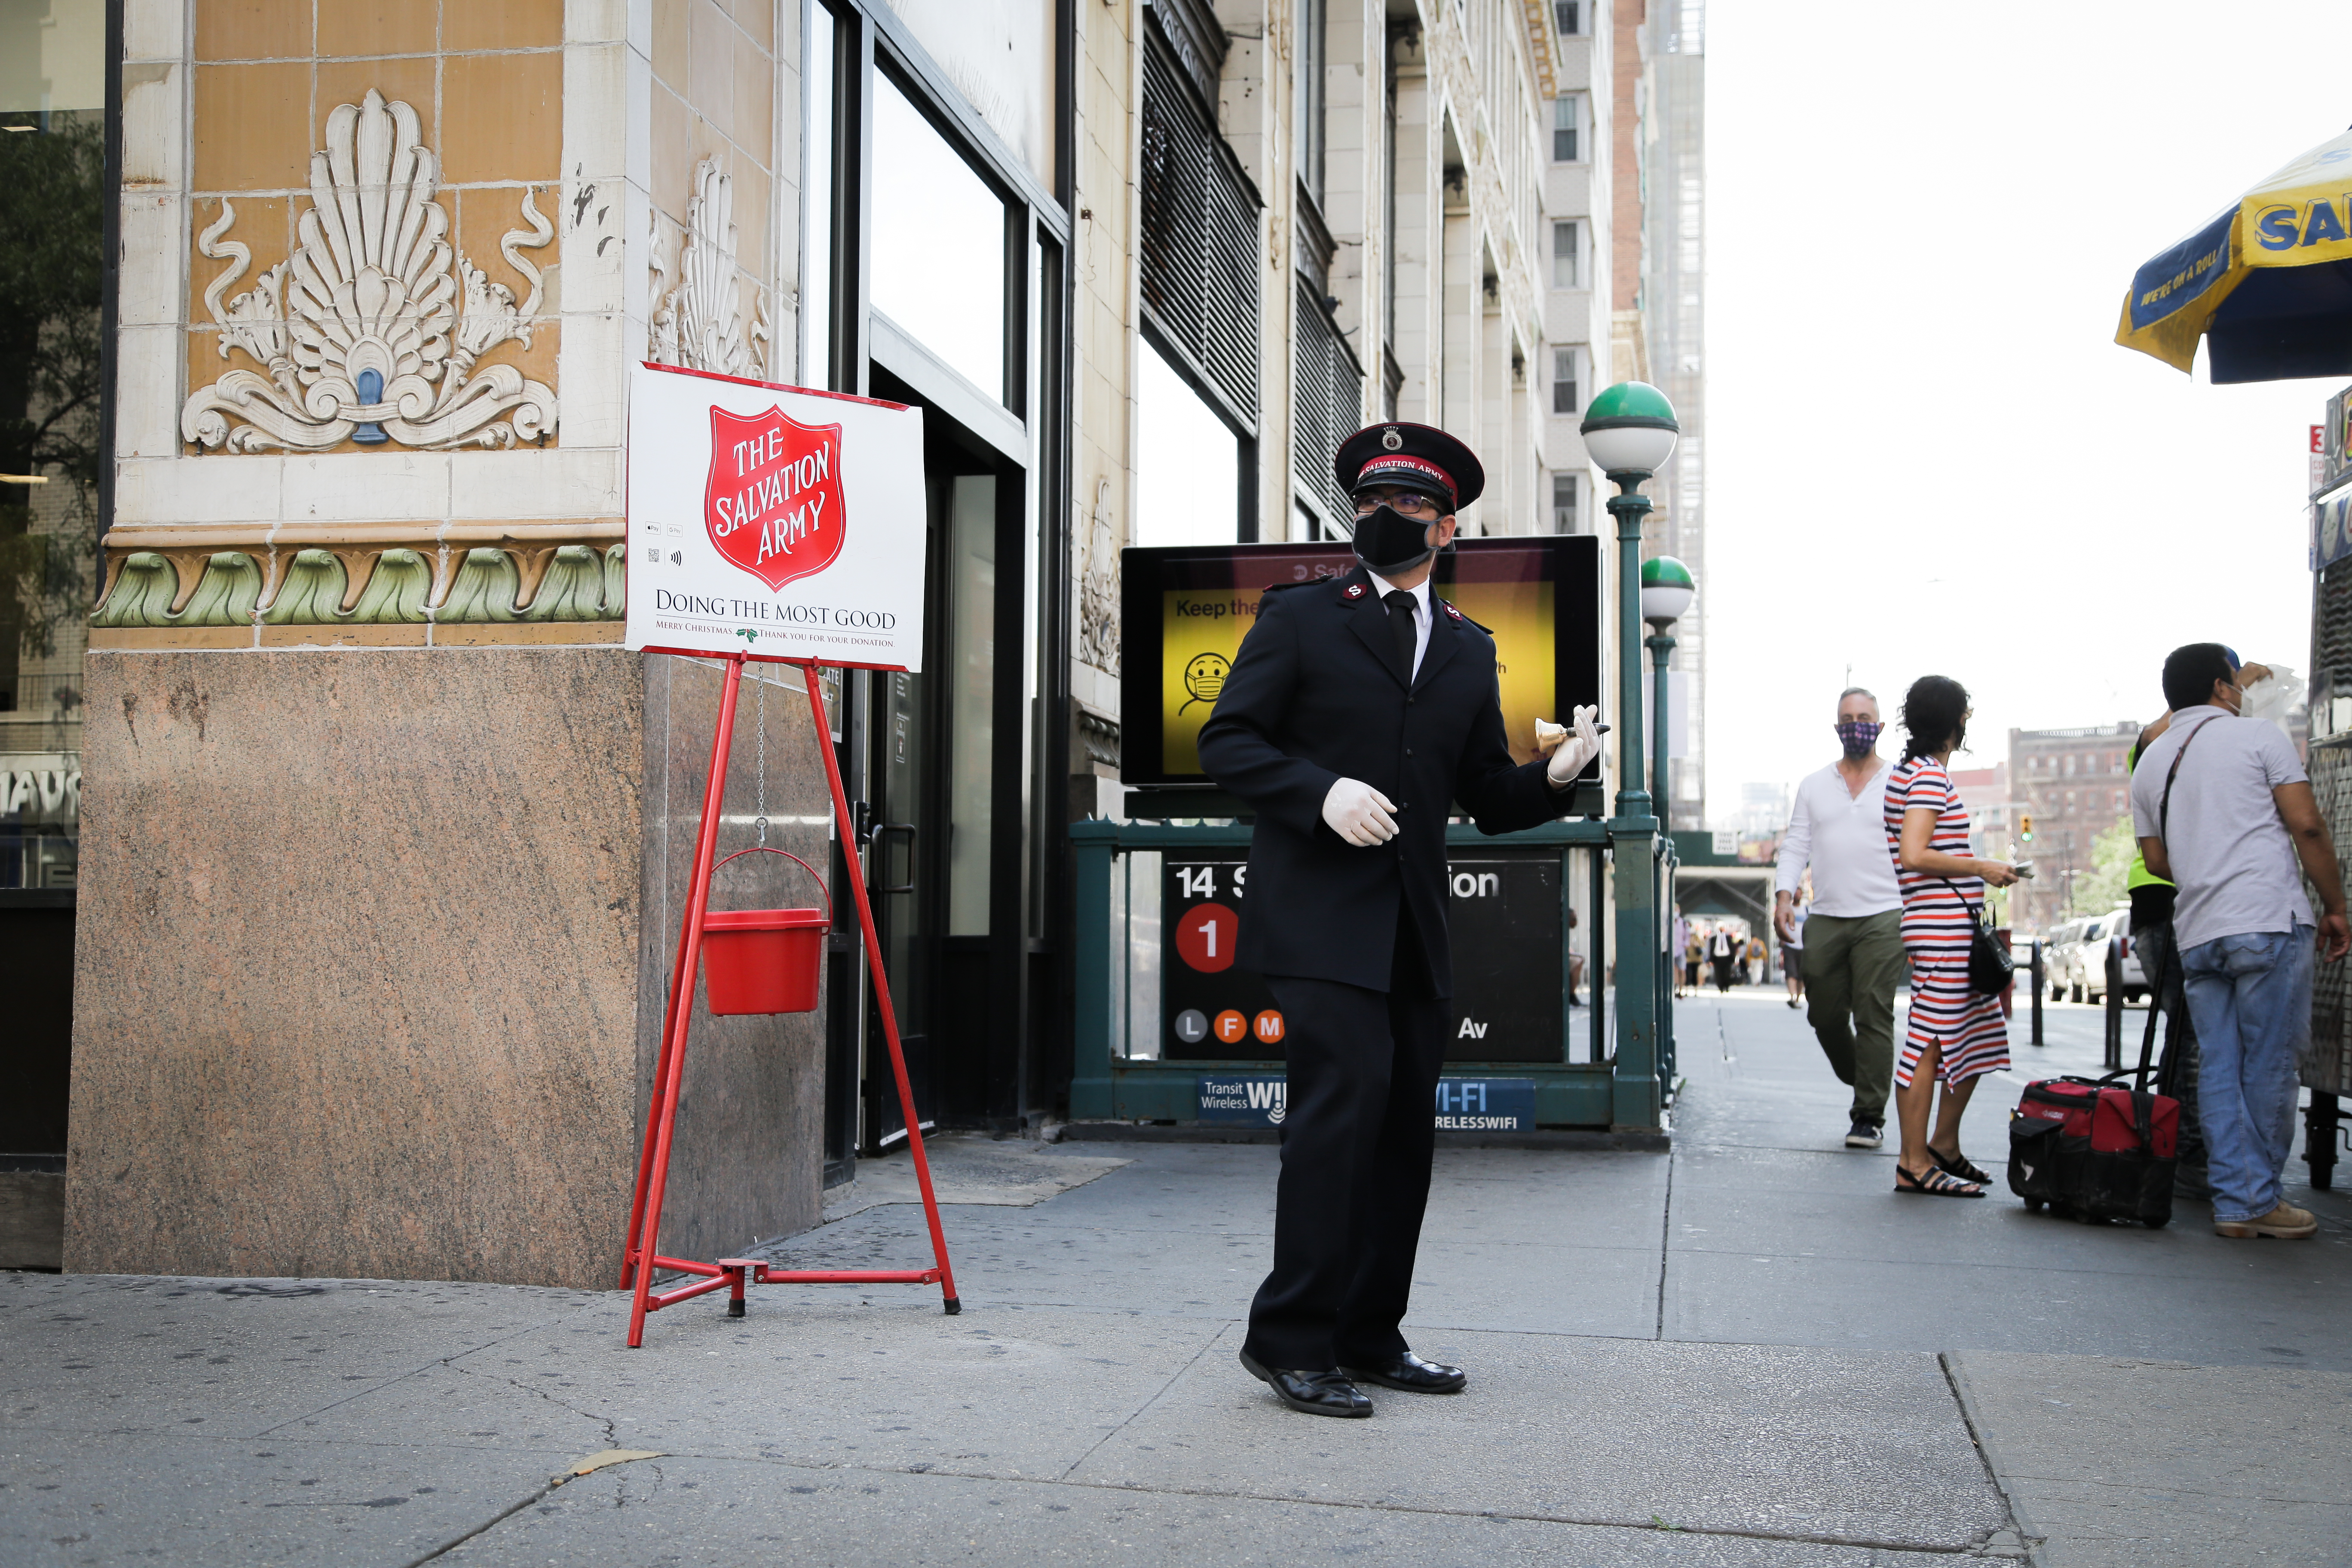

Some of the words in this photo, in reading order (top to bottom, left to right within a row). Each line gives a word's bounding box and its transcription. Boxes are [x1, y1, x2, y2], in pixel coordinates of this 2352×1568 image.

[2255, 192, 2352, 251] SA
[2173, 270, 2186, 290] ON
[2187, 265, 2193, 281] A
[732, 426, 784, 478] THE
[1365, 460, 1415, 473] SALVATION
[1418, 465, 1443, 480] ARMY
[715, 441, 829, 537] SALVATION
[756, 491, 826, 566] ARMY
[1348, 585, 1361, 596] S
[656, 589, 725, 615] DOING
[730, 600, 769, 619] THE
[775, 604, 830, 624] MOST
[835, 609, 895, 629] GOOD
[1177, 600, 1226, 619] Keep
[1230, 599, 1259, 615] the
[656, 620, 683, 630] MERRY
[685, 623, 734, 634] CHRISTMAS.
[759, 629, 788, 639] THANK
[827, 636, 848, 644] YOUR
[851, 638, 895, 647] DONATION.
[1176, 867, 1216, 898] 14
[1198, 920, 1216, 957] 1
[1186, 1017, 1199, 1035] L
[1224, 1018, 1238, 1036] F
[1261, 1017, 1279, 1036] M
[1458, 1017, 1488, 1038] Av
[1205, 1082, 1243, 1094] Transit
[1201, 1096, 1248, 1109] Wireless
